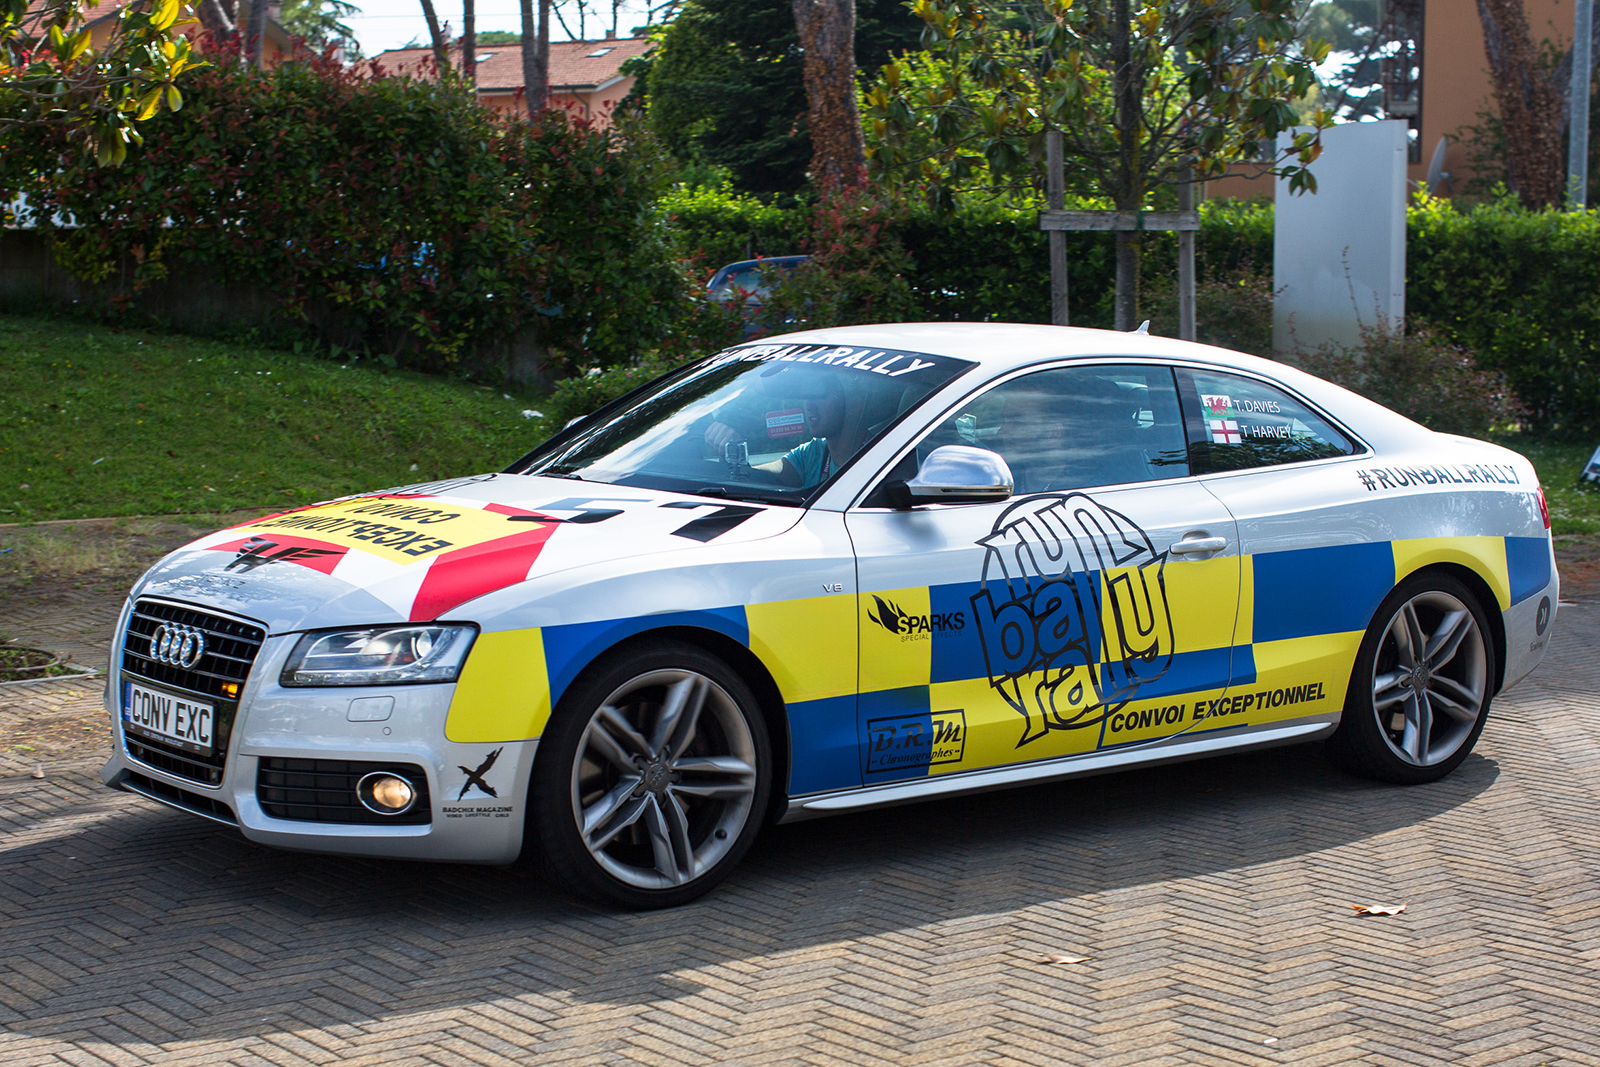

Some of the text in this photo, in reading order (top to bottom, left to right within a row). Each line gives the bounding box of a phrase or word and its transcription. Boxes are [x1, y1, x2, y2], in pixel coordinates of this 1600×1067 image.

[1251, 426, 1292, 438] HARVEY
[1356, 464, 1520, 492] #RUNBALLRALLY
[822, 583, 843, 593] V8
[897, 611, 965, 634] SPARKS
[901, 631, 962, 642] SPECIAL EFFECTS
[132, 688, 171, 732] CONV
[175, 701, 210, 744] EXC
[1110, 682, 1326, 733] CONVOI EXCEPTIONNEL
